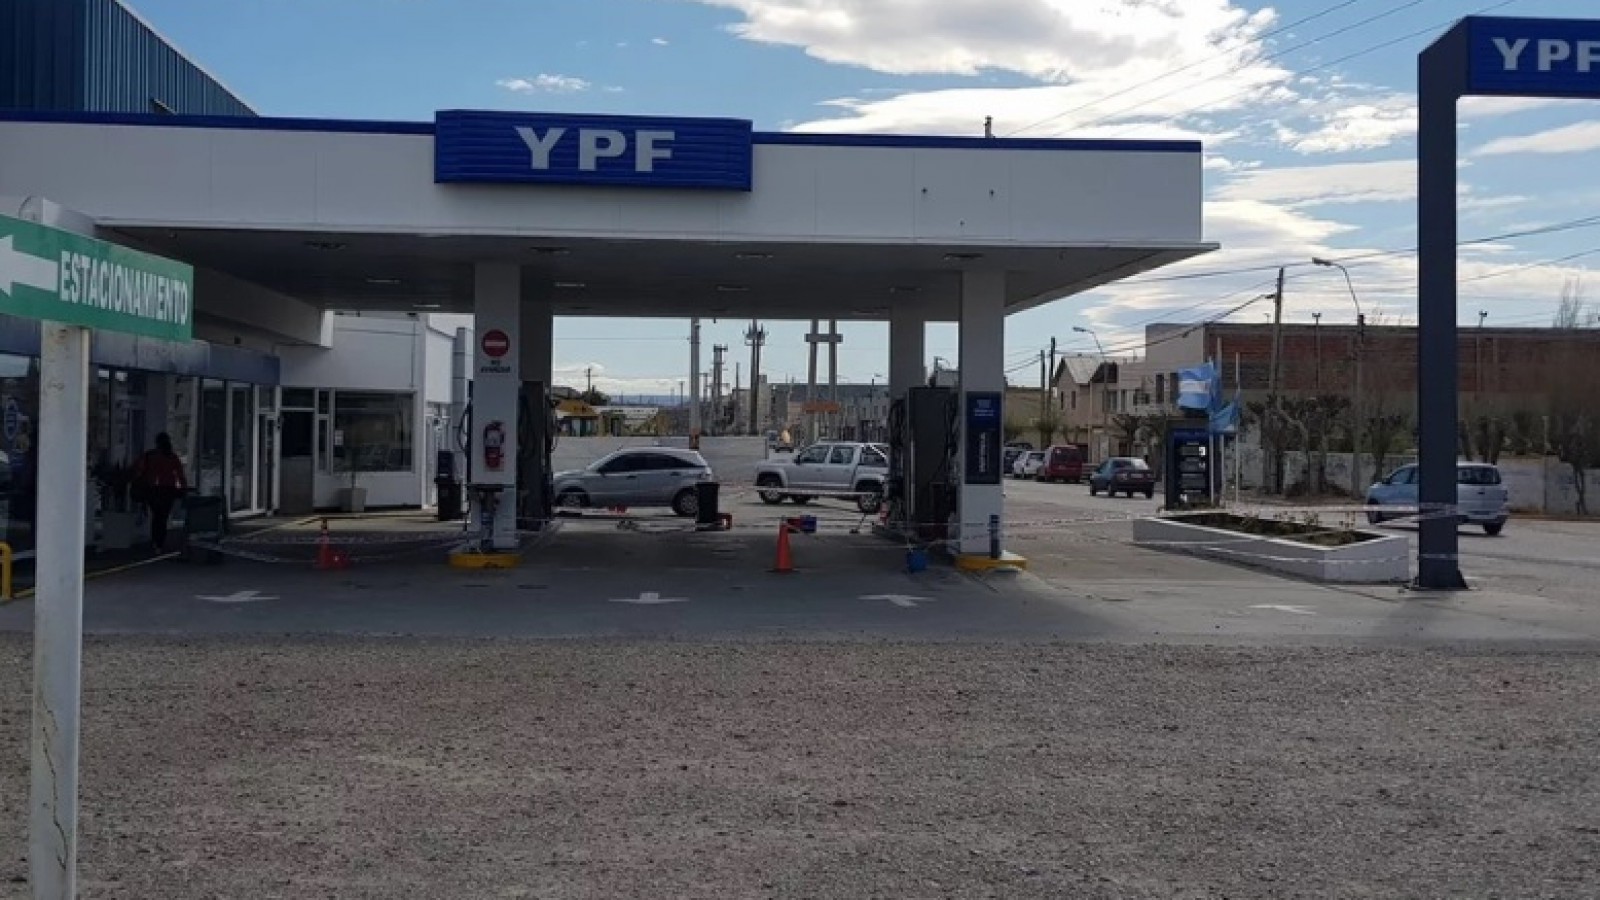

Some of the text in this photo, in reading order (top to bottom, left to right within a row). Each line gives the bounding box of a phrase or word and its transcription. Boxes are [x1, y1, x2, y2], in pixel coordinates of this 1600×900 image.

[1491, 37, 1600, 73] YPF
[514, 126, 676, 173] YPF
[59, 249, 189, 326] ESTACIONAMIENTO
